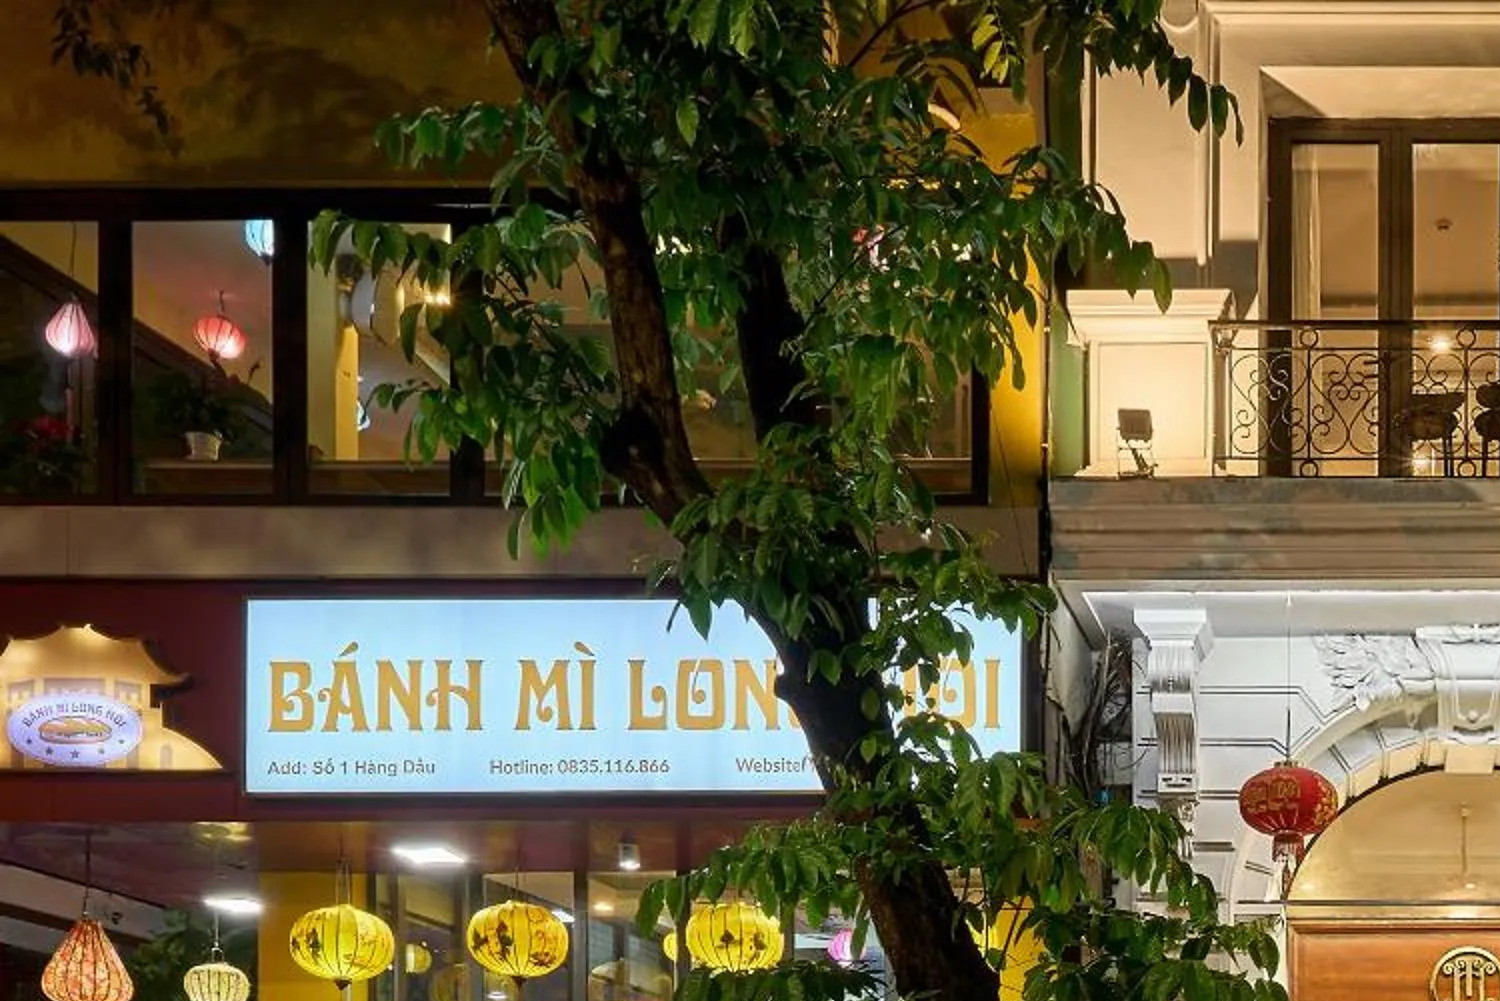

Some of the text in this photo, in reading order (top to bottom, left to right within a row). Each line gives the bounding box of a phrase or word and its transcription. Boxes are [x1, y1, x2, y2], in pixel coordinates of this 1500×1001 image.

[267, 642, 484, 732] BÁNH
[514, 641, 597, 731] MÌ
[627, 658, 802, 731] LON
[267, 759, 307, 775] Add:
[312, 757, 335, 775] Số
[341, 761, 348, 775] 1
[355, 759, 397, 777] Hàng
[490, 759, 671, 775] Hotline: 0835.116.866
